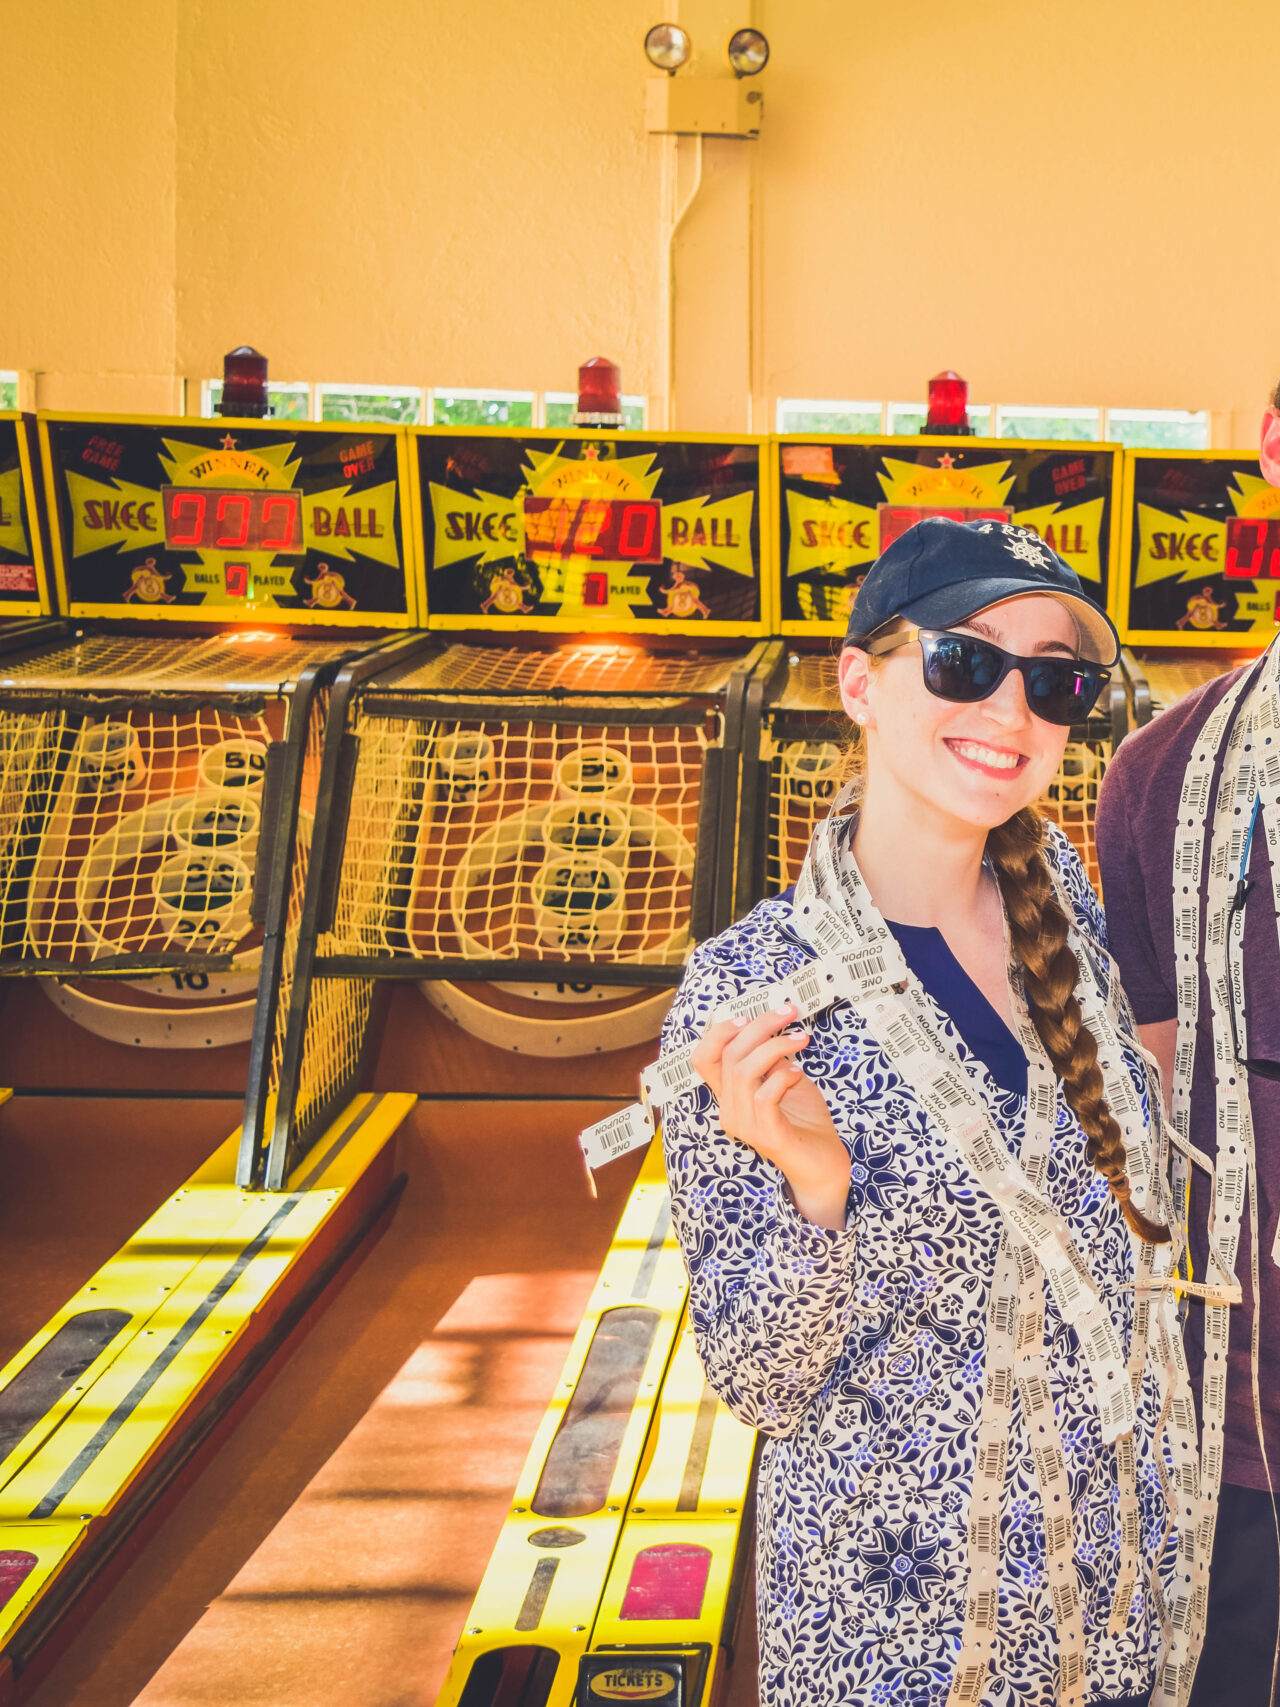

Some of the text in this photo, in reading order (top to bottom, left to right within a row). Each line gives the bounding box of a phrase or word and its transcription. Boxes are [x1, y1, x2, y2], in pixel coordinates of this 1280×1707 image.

[339, 441, 375, 463] GAME
[189, 456, 270, 482] WINNER
[343, 458, 375, 478] OVER
[1052, 459, 1086, 480] GAME
[1055, 475, 1087, 496] OVER
[84, 500, 157, 532] SKEE
[312, 506, 385, 538] BALL
[445, 511, 741, 548] SKEE BALL
[978, 524, 993, 533] 4
[801, 519, 870, 549] SKEE
[1150, 532, 1219, 561] SKEE
[194, 573, 285, 587] BALLS PLAYED
[610, 585, 641, 595] PLAYED
[1246, 602, 1271, 612] BALLS
[1212, 712, 1228, 749] COUPON
[225, 752, 266, 770] 50
[1182, 784, 1190, 803] ONE
[1199, 773, 1210, 815] COUPON
[1269, 828, 1277, 845] ONE
[1192, 839, 1201, 882] COUPON
[823, 910, 853, 945] COUPON
[812, 938, 828, 956] ONE
[841, 945, 883, 964] COUPON
[792, 967, 817, 987] COUPON
[1075, 949, 1091, 983] COUPON
[171, 972, 209, 990] 10
[730, 991, 769, 1012] COUPON
[911, 989, 926, 1009] ONE
[899, 1013, 931, 1053] COUPON
[917, 1014, 945, 1054] COUPON
[1098, 1010, 1115, 1047] COUPON
[882, 1039, 900, 1059] ONE
[672, 1078, 692, 1094] ONE
[943, 1070, 976, 1107] COUPON
[1121, 1075, 1137, 1112] COUPON
[928, 1092, 947, 1110] ONE
[594, 1112, 631, 1136] COUPON
[611, 1141, 631, 1157] ONE
[968, 1151, 983, 1172] ONE
[983, 1129, 1005, 1172] COUPON
[1235, 1167, 1244, 1210] COUPON
[1009, 1210, 1042, 1248] COUPON
[1014, 1246, 1025, 1285] COUPON
[1050, 1268, 1068, 1309] COUPON
[1016, 1314, 1025, 1349] COUPON
[1102, 1318, 1121, 1360] COUPON
[1084, 1342, 1096, 1362] ONE
[1149, 1344, 1159, 1363] ONE
[1172, 1334, 1184, 1370] COUPON
[1018, 1377, 1032, 1417] COUPON
[1041, 1379, 1050, 1400] ONE
[1122, 1383, 1132, 1422] COUPON
[1185, 1397, 1195, 1434] COUPON
[1034, 1448, 1048, 1487] COUPON
[1052, 1586, 1063, 1625] COUPON
[1071, 1587, 1080, 1606] ONE
[968, 1598, 976, 1621] ONE
[988, 1588, 996, 1631] COUPON
[604, 1674, 663, 1688] TICKETS
[953, 1671, 963, 1693] ONE
[971, 1663, 986, 1703] COUPON
